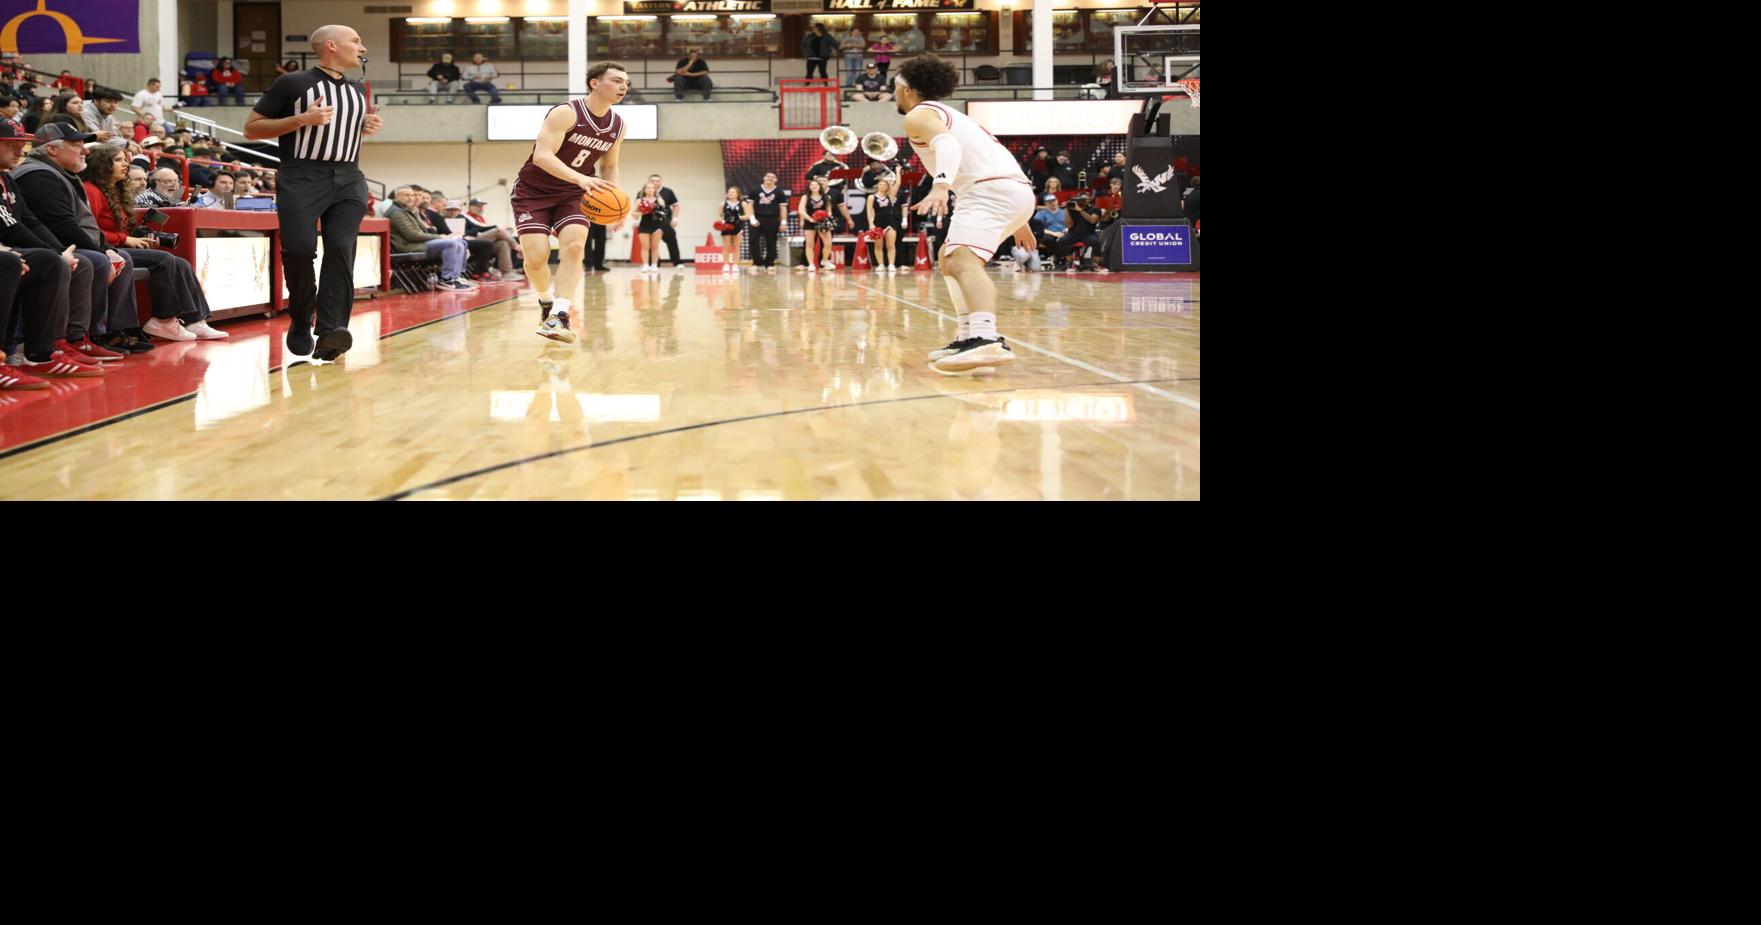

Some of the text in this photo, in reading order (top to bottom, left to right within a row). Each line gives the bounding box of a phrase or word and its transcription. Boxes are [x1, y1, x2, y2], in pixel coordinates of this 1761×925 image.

[683, 1, 762, 10] ATHLETIC
[829, 0, 872, 8] HALL
[568, 132, 613, 152] MONTANA
[571, 149, 591, 168] 8
[1129, 232, 1183, 241] GLOBAL
[695, 252, 735, 263] DEFENE
